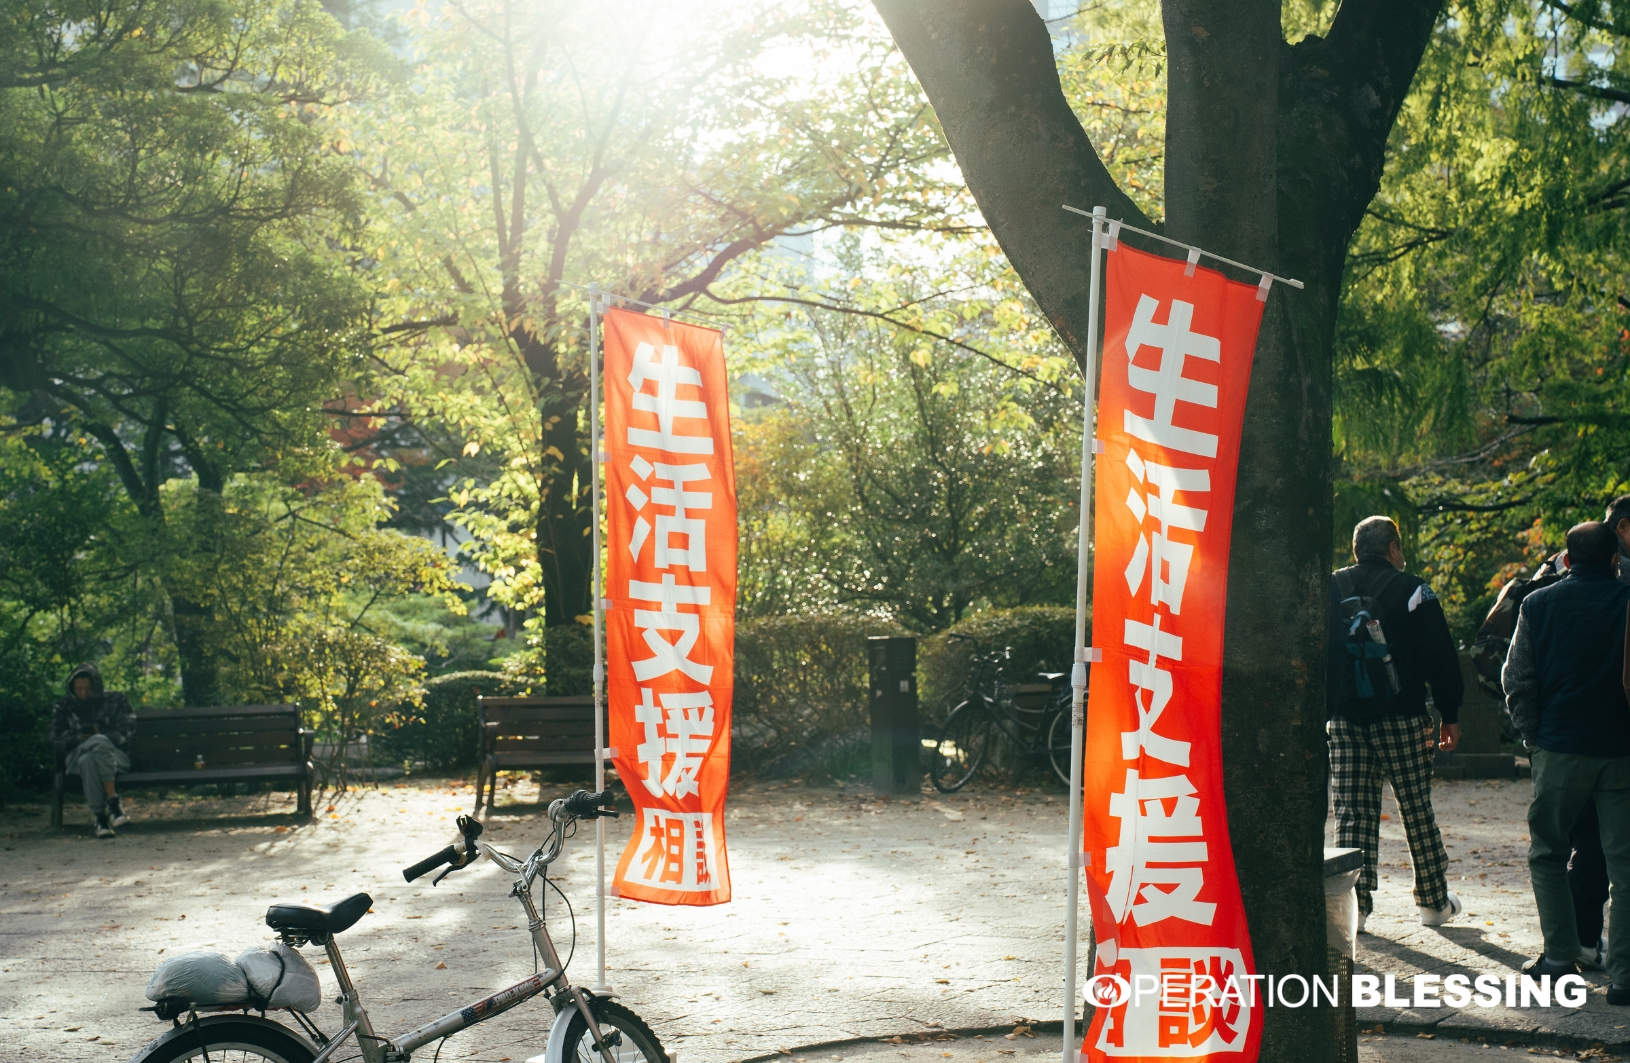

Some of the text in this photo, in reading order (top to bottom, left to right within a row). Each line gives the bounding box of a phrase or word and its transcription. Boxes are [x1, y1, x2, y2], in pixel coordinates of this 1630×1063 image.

[626, 342, 714, 799] 生活支援
[1104, 293, 1221, 927] 生活支援
